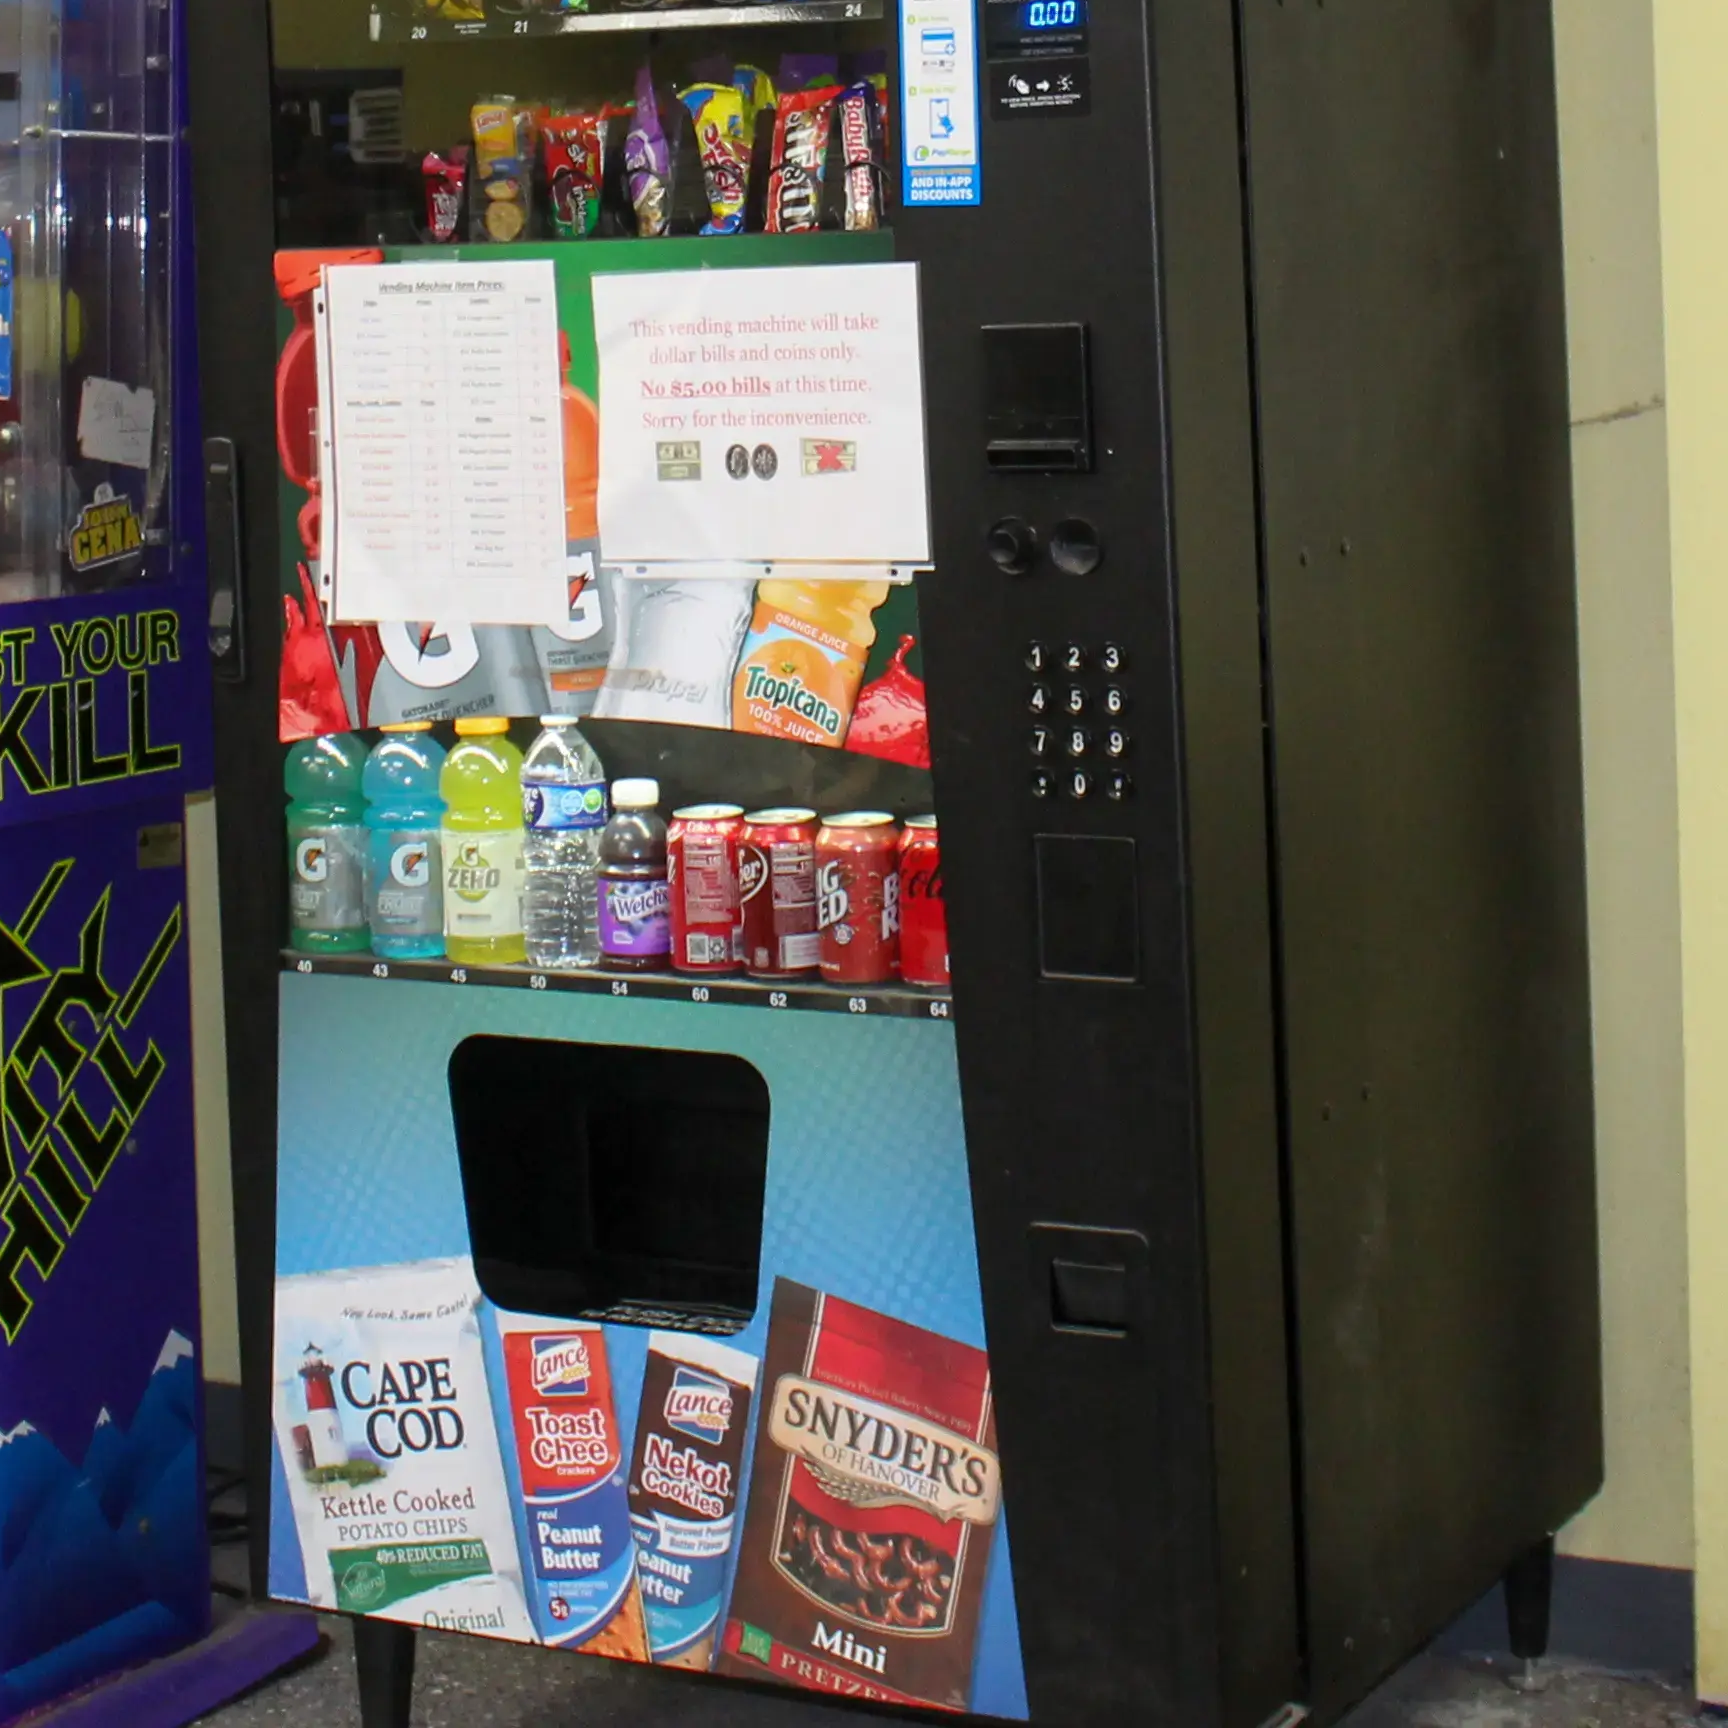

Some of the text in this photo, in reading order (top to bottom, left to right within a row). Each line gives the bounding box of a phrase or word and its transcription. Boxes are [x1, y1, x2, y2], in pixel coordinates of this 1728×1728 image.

[845, 3, 862, 17] 24
[1029, 0, 1076, 26] 0.00
[412, 27, 427, 39] 20
[514, 21, 528, 33] 21
[845, 97, 869, 150] Baby
[911, 176, 972, 189] AND IN-APP
[911, 188, 974, 202] DISCOUNTS
[378, 282, 413, 294] Vending
[415, 281, 452, 292] Machine
[455, 280, 474, 291] Item
[629, 312, 879, 338] This vending machine will take
[649, 340, 861, 365] dollar bills and coins only.
[641, 375, 872, 398] No $5.00 bills at this time.
[642, 408, 873, 431] Sorry for the inconvenience.
[74, 516, 141, 564] CENA
[53, 610, 181, 674] YOUR
[775, 612, 850, 652] ORANGE JUICE
[1032, 646, 1119, 668] 1 2 3
[633, 671, 709, 703] propel
[401, 699, 444, 718] GATORADE
[442, 694, 497, 719] QUENCHER
[746, 665, 841, 734] Tropicana
[1032, 688, 1121, 711] 4 5 6
[748, 704, 824, 744] 100% JUICE
[1035, 731, 1123, 753] 7 8 9
[1074, 773, 1086, 795] 0
[297, 838, 327, 882] G
[391, 842, 429, 886] G
[448, 867, 502, 889] ZERO
[297, 961, 313, 973] 40
[372, 964, 388, 978] 43
[450, 970, 467, 983] 45
[531, 976, 547, 989] 50
[612, 982, 628, 995] 54
[692, 988, 709, 1002] 60
[769, 993, 787, 1007] 62
[849, 997, 867, 1012] 63
[929, 1003, 948, 1018] 64
[340, 1306, 363, 1320] New
[400, 1309, 432, 1321] Same
[532, 1343, 589, 1384] Lance
[341, 1358, 458, 1410] CAPE
[667, 1389, 733, 1418] Lance
[366, 1406, 465, 1460] COD
[528, 1409, 606, 1438] Toast
[533, 1438, 609, 1467] Chee
[784, 1388, 988, 1497] SNYDER'S
[645, 1434, 732, 1496] Nekot
[822, 1444, 941, 1502] OF HANOVER
[320, 1486, 476, 1520] Kettle Cooked
[643, 1471, 724, 1518] Cookies
[537, 1509, 558, 1521] real
[339, 1516, 469, 1542] POTATO CHIPS
[538, 1522, 603, 1546] Peanut
[397, 1543, 485, 1564] REDUCED FAT
[541, 1547, 601, 1571] Butter
[637, 1549, 693, 1584] eanut
[423, 1606, 506, 1632] Original
[552, 1600, 568, 1617] 5g
[811, 1620, 889, 1675] Mini
[780, 1651, 890, 1702] PRETZE
